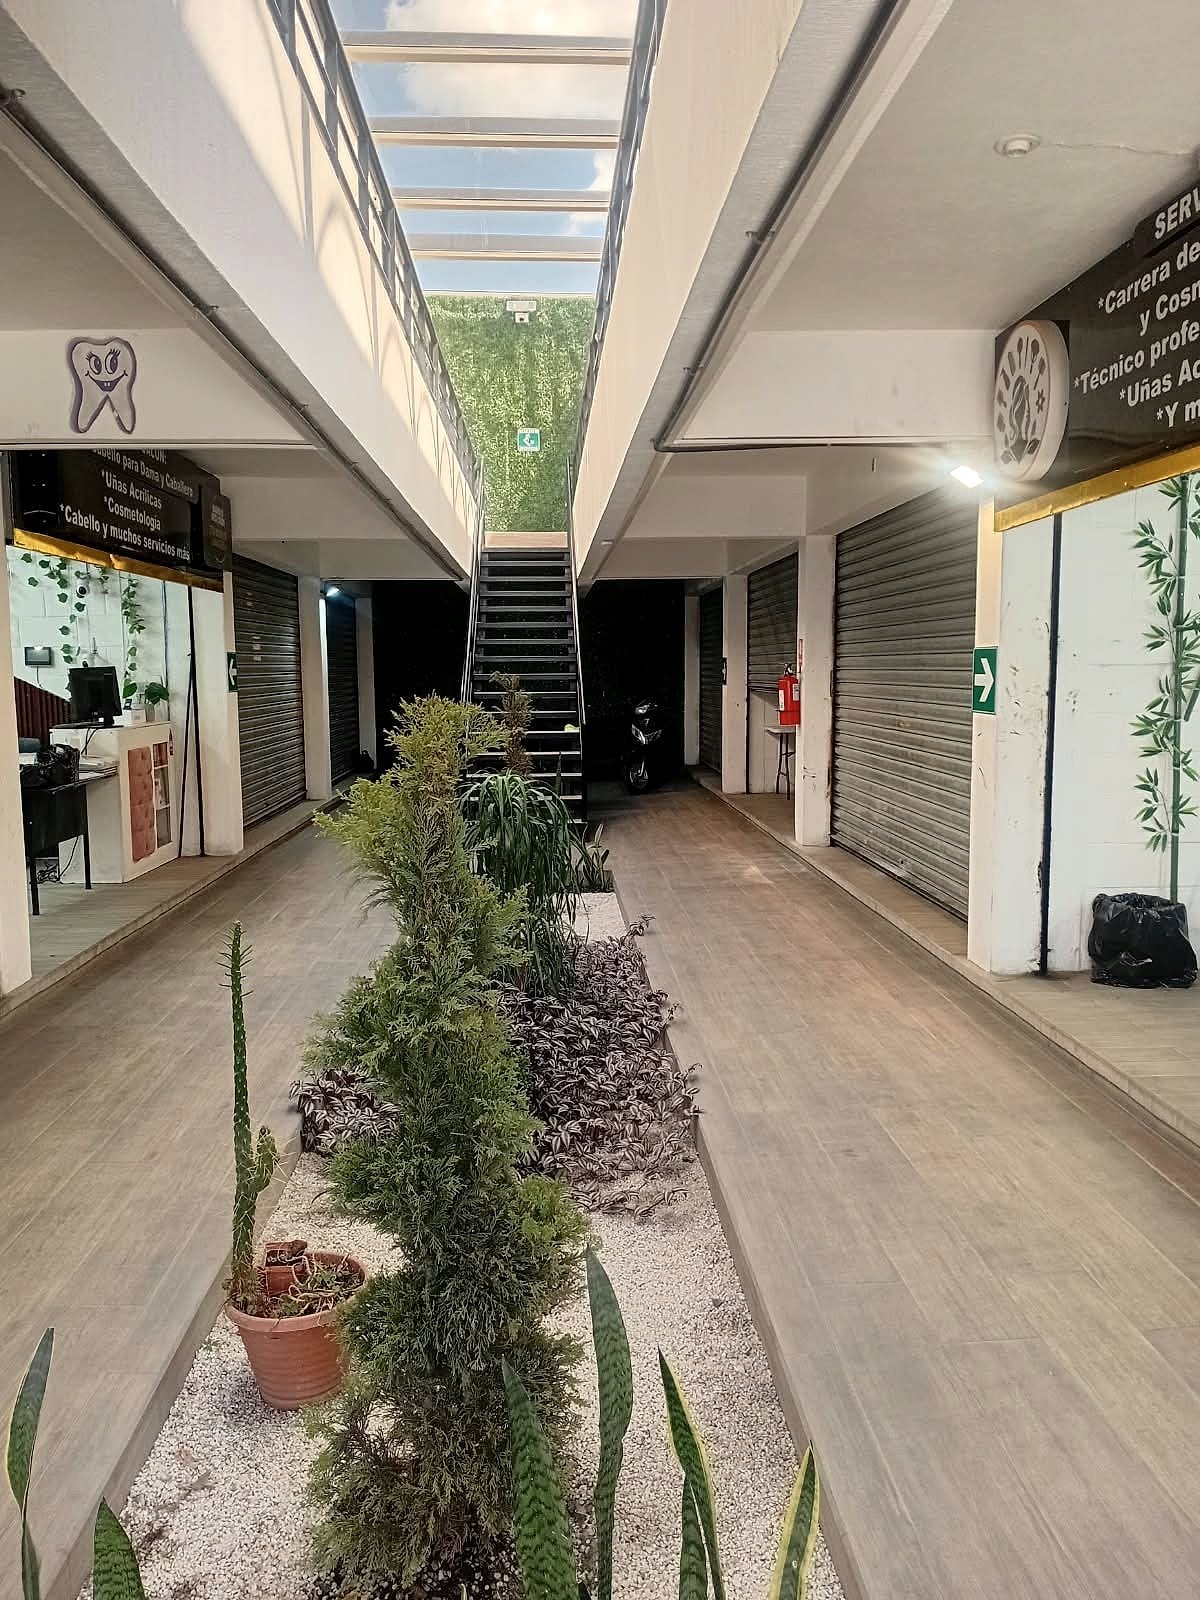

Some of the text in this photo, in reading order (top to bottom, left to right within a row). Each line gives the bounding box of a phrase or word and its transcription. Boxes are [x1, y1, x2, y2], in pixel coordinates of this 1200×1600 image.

[1176, 241, 1200, 271] de
[1139, 309, 1150, 337] y
[122, 455, 139, 472] para
[102, 522, 109, 539] y
[110, 523, 142, 546] muchos
[143, 538, 176, 557] servicios
